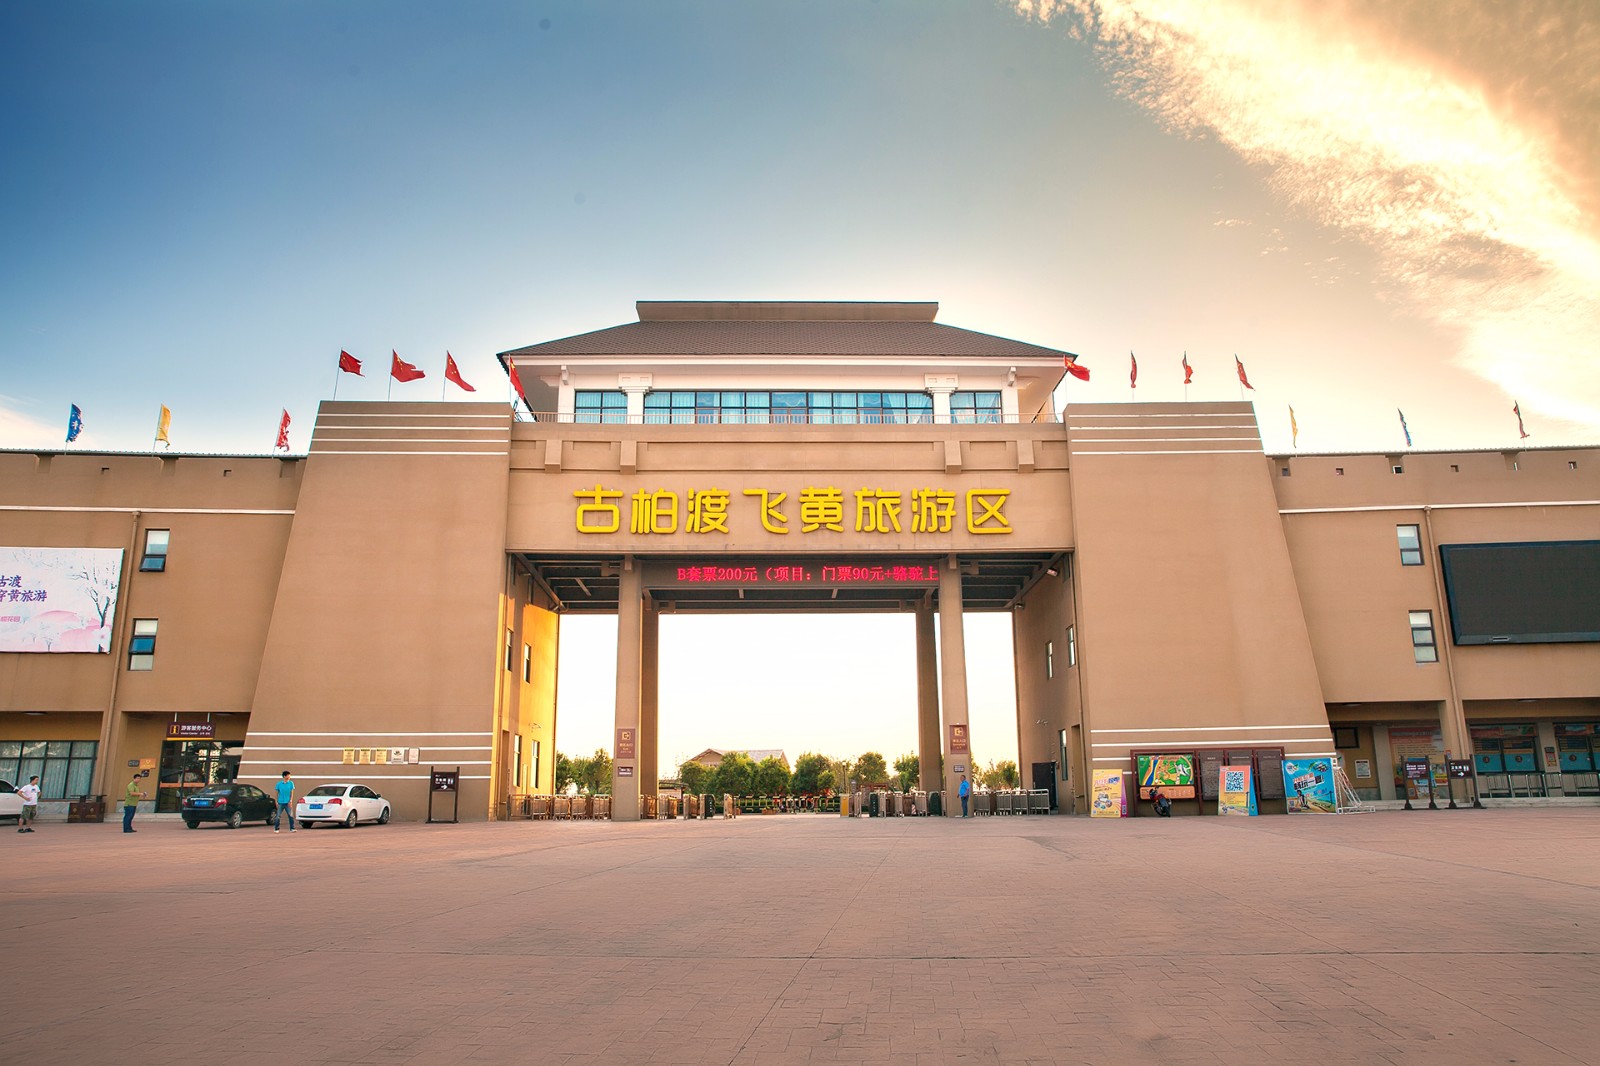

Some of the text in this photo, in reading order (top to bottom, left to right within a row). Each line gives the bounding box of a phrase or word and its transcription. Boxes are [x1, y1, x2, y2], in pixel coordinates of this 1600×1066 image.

[573, 485, 1013, 534] 古柏渡飞黄旅游区
